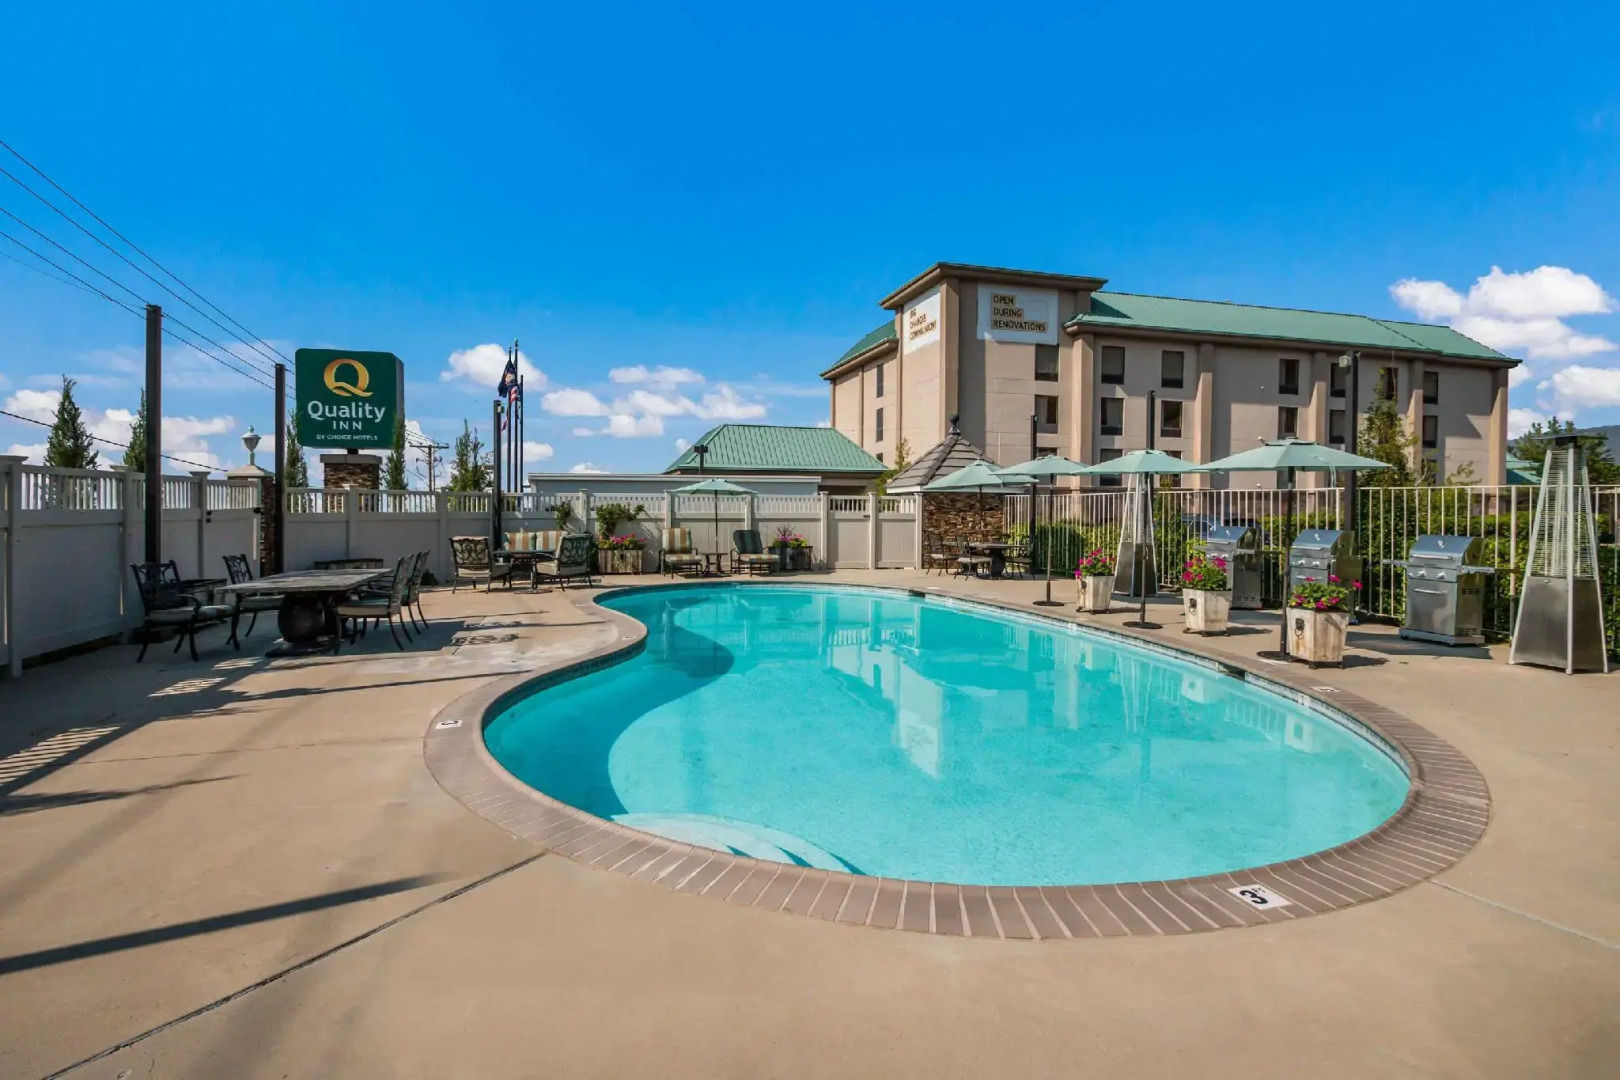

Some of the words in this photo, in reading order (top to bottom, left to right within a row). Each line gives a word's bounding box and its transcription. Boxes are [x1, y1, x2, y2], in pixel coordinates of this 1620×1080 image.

[993, 295, 1014, 305] OPEN
[993, 308, 1022, 318] DURING
[993, 320, 1046, 332] RENOVATIONS
[323, 358, 374, 397] Q
[307, 400, 386, 423] Quality
[333, 420, 362, 430] INN
[1239, 890, 1268, 904] 3
